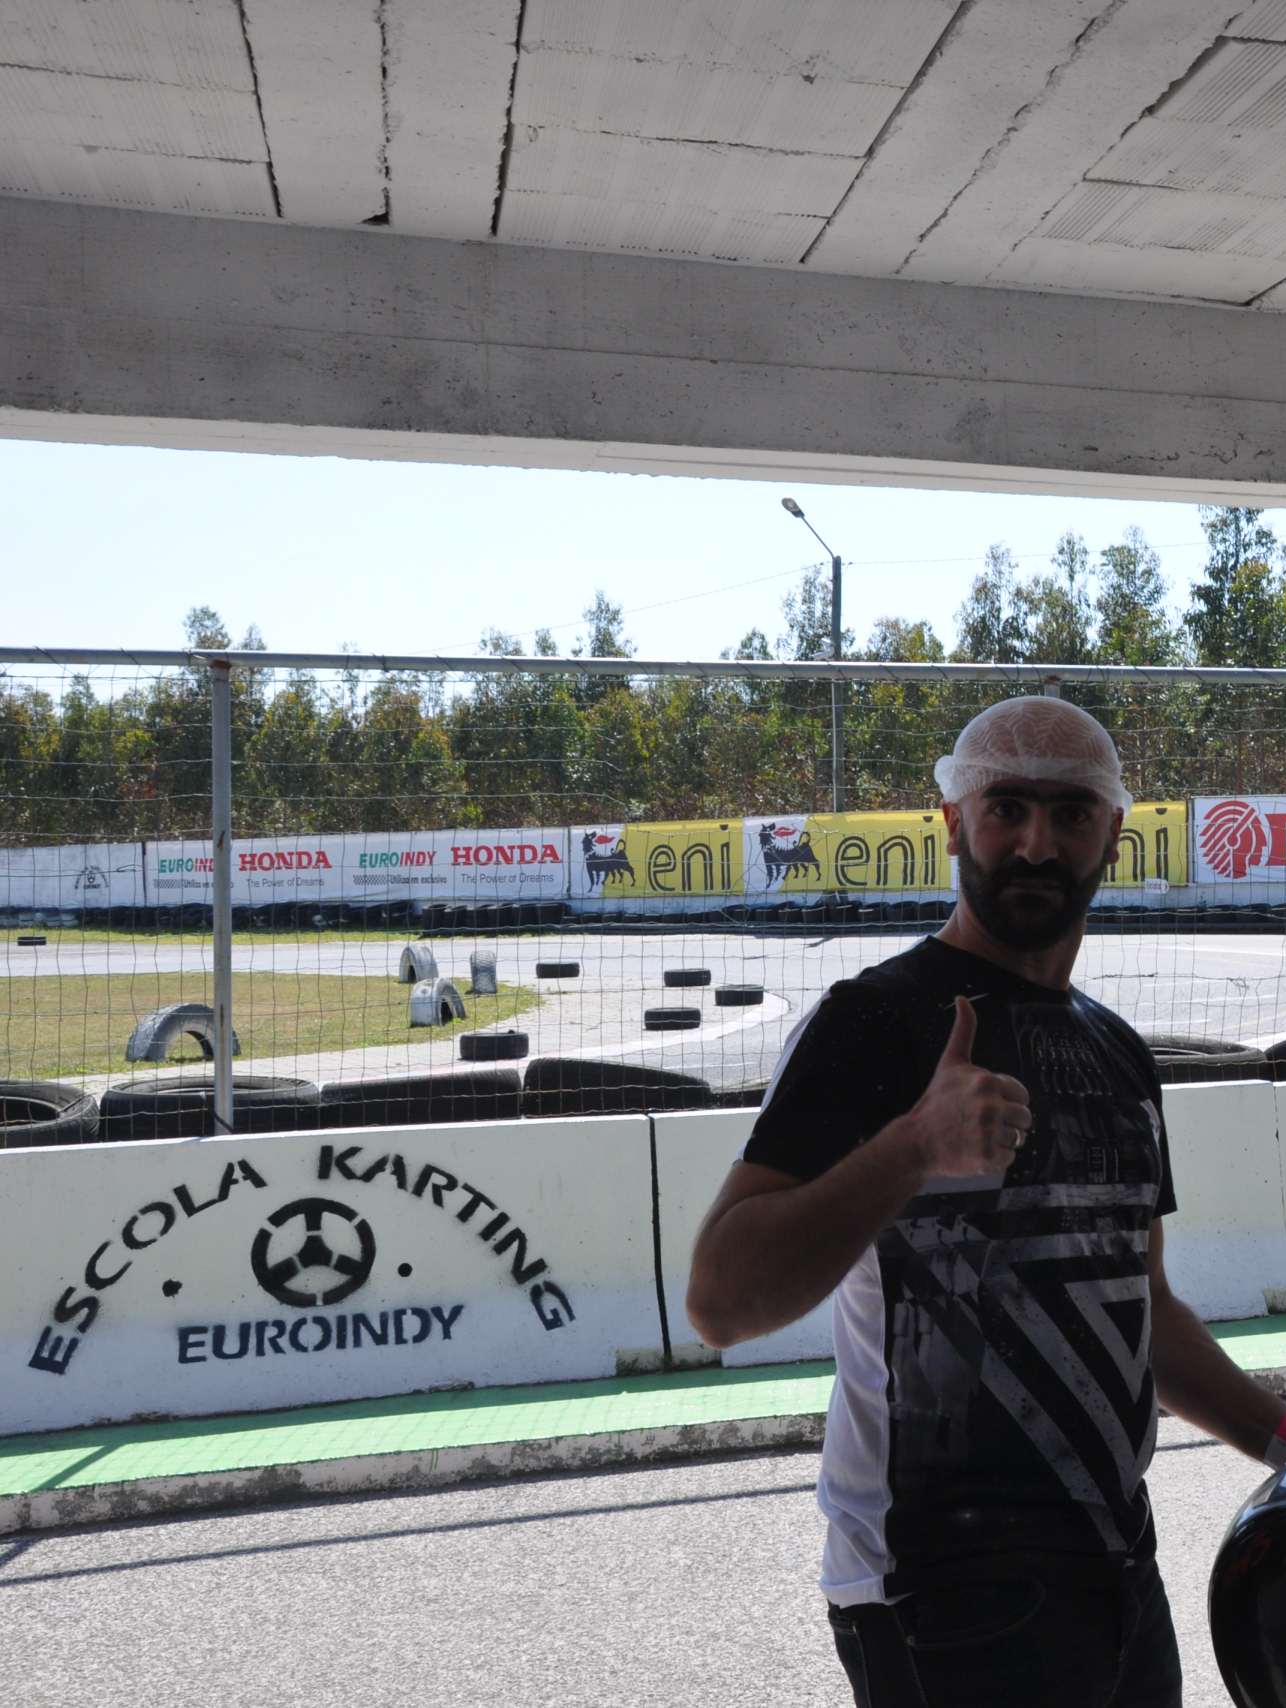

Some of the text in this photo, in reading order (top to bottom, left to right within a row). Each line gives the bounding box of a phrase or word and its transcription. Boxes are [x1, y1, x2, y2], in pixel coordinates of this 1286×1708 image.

[450, 844, 563, 866] HONDA
[834, 815, 936, 886] eni
[1103, 806, 1169, 882] ni
[159, 857, 214, 873] EUROIND
[238, 851, 333, 872] HONDA
[359, 850, 438, 869] EUROINDY
[649, 824, 731, 892] eni
[262, 878, 284, 888] Power
[462, 872, 555, 884] The Power of Dreams
[28, 1144, 576, 1375] ESCOLA KARTING
[178, 1304, 465, 1364] EUROINDY
